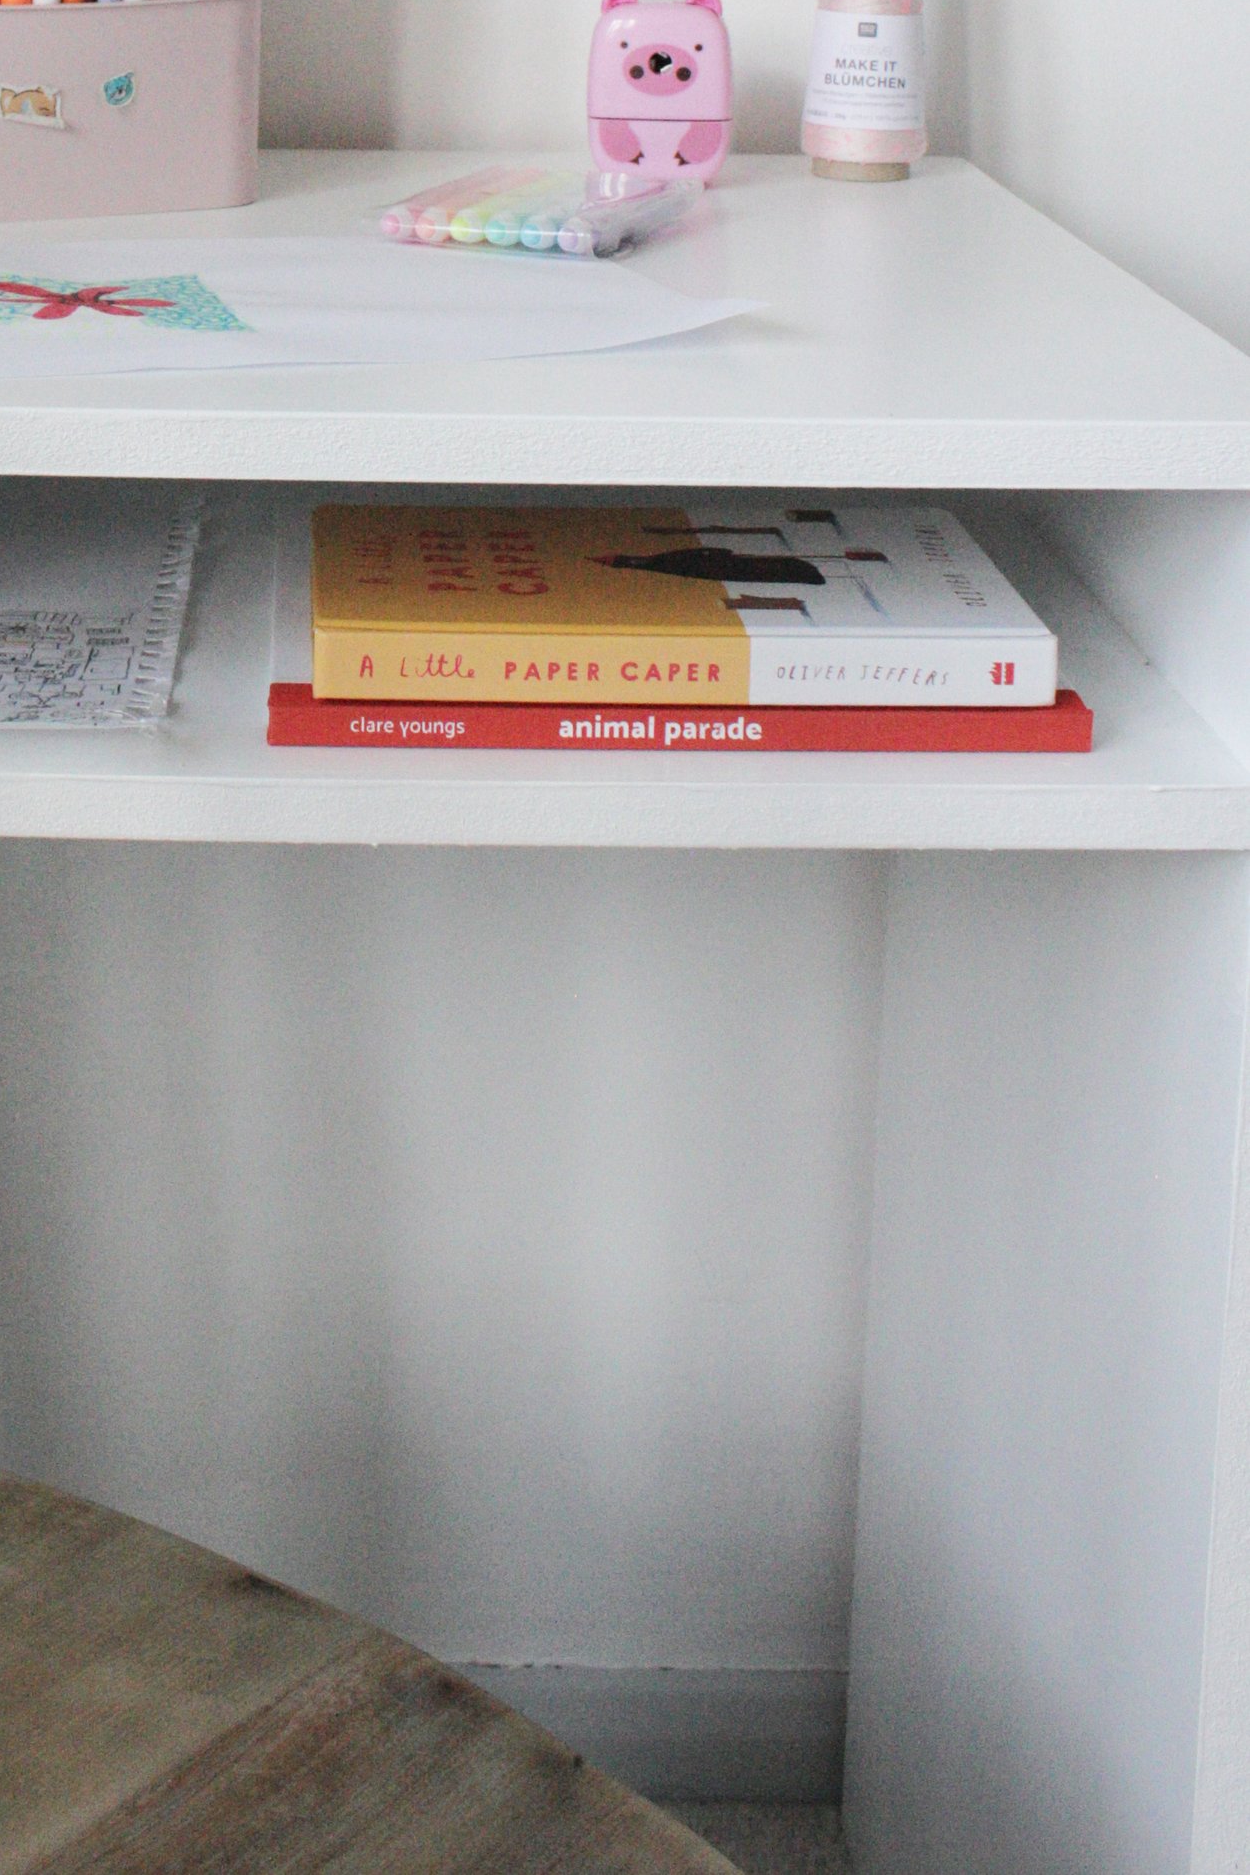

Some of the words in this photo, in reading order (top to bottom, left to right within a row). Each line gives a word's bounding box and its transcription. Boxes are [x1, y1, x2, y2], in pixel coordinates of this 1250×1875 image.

[835, 58, 879, 71] MAKE
[884, 61, 897, 72] IT
[824, 72, 906, 89] BLÜMCHEN
[358, 655, 375, 678] A
[504, 661, 600, 681] PAPER
[620, 661, 721, 682] CAPER
[776, 665, 846, 680] OLIVER
[860, 664, 950, 686] JEFFERS
[350, 715, 395, 734] clare
[400, 717, 466, 736] youngs
[558, 715, 655, 739] animal
[664, 716, 763, 746] parade
